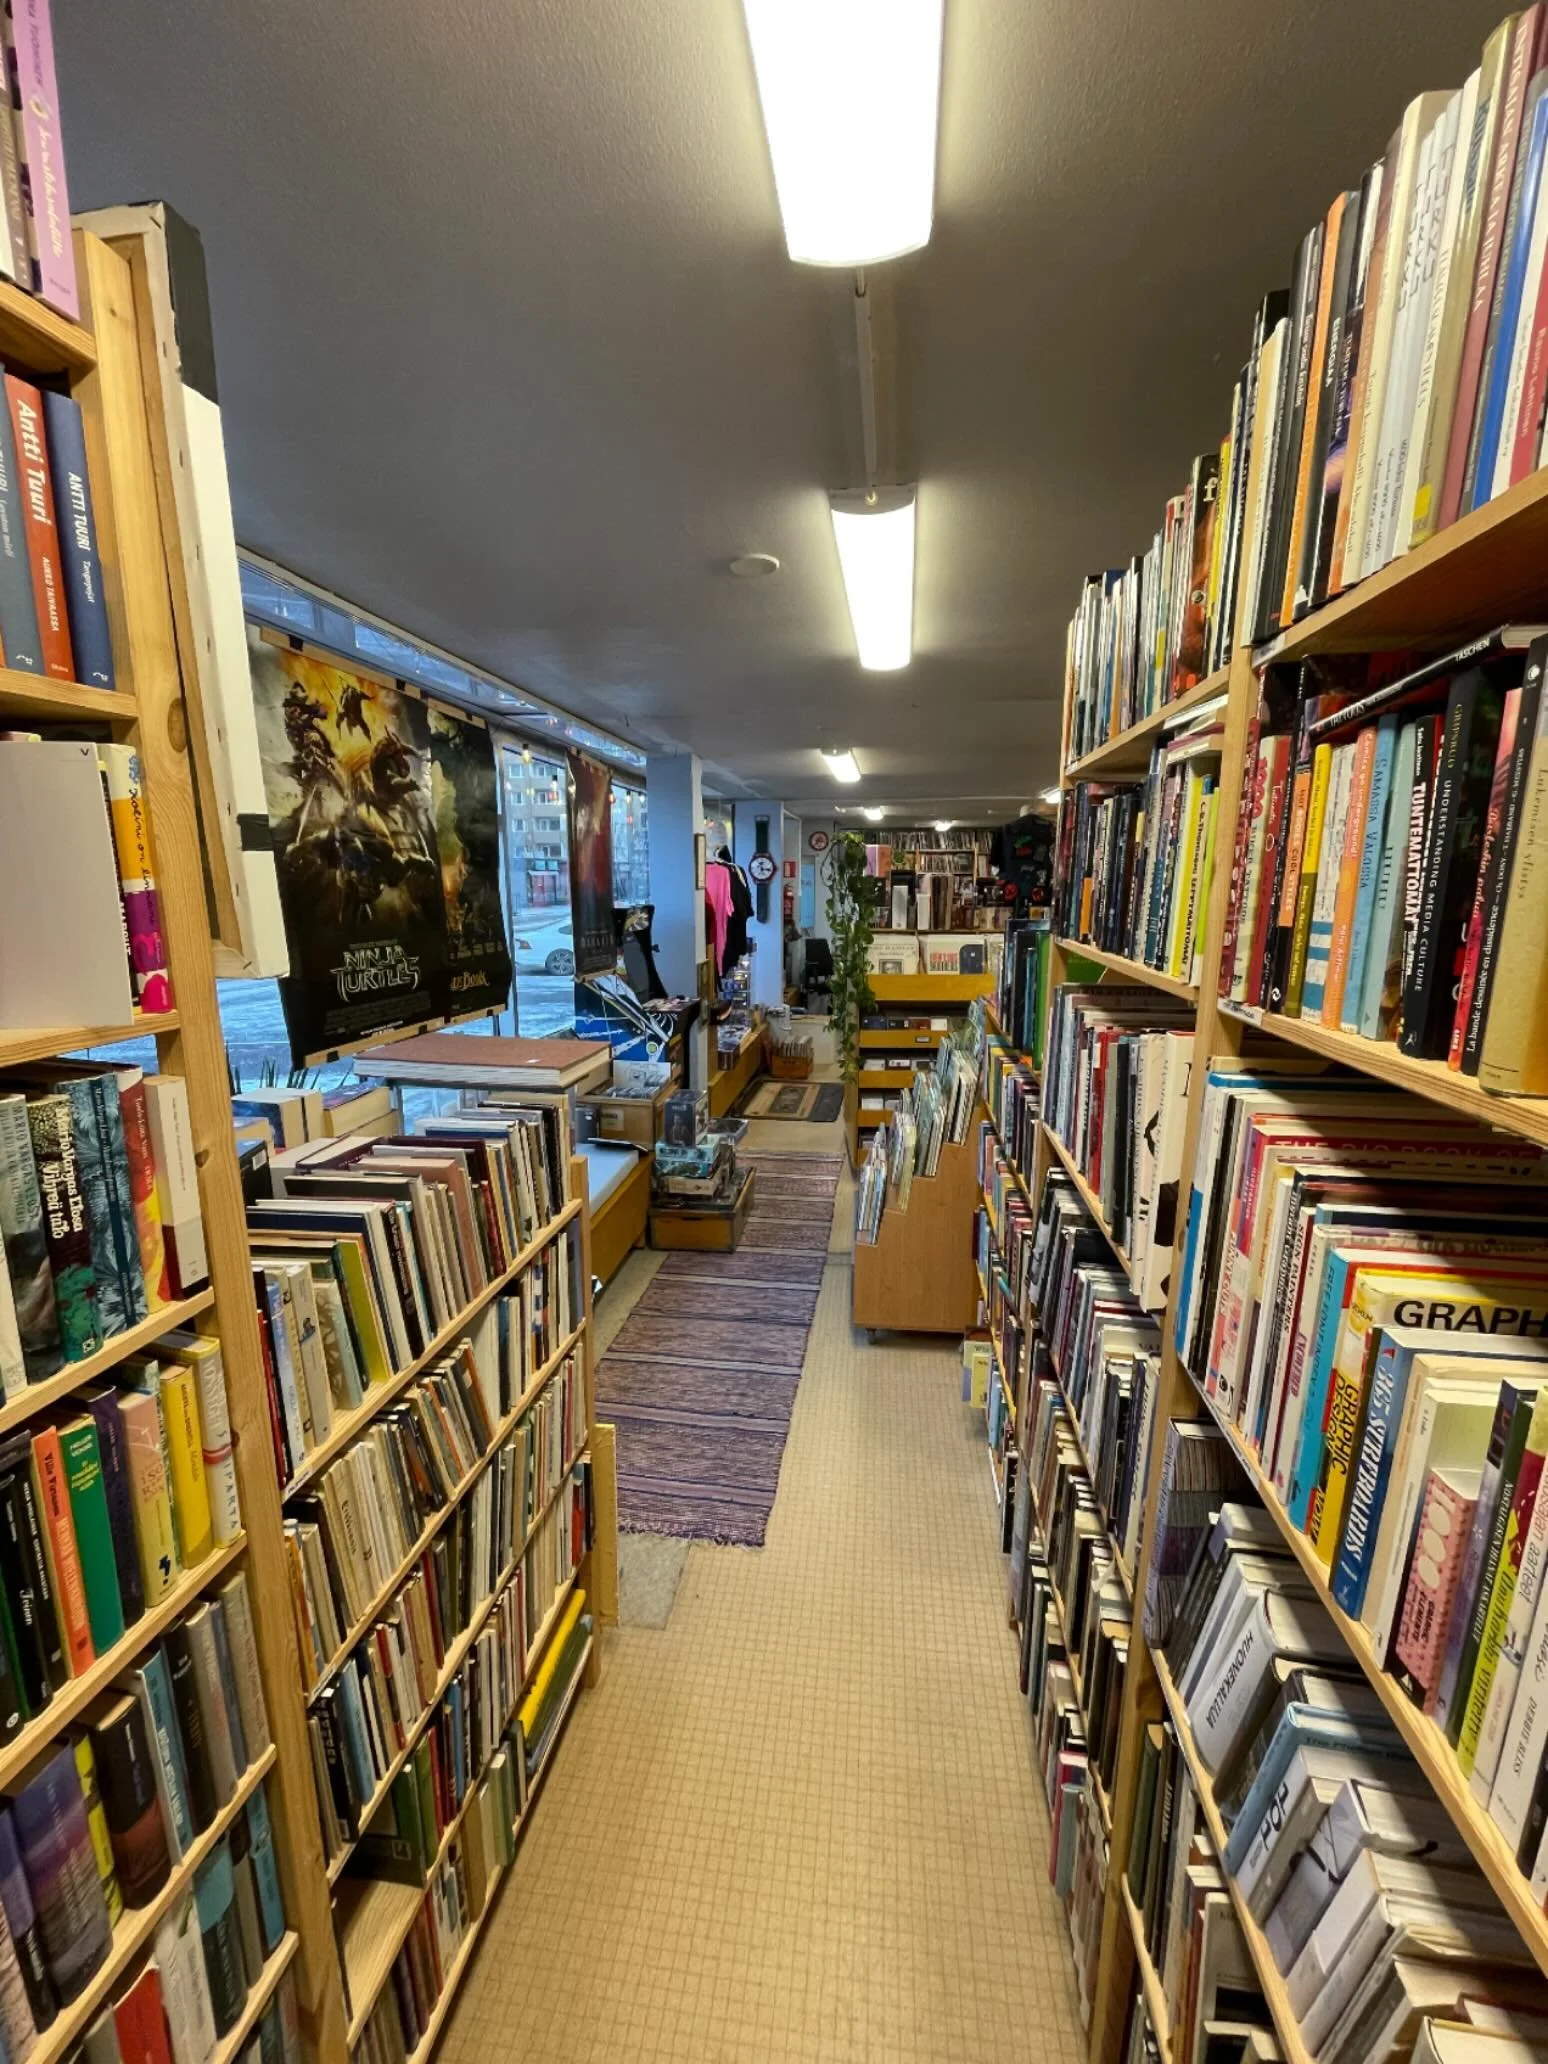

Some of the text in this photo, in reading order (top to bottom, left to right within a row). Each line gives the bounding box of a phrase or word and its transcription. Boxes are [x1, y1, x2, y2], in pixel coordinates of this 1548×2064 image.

[1491, 142, 1509, 209] ARKEA
[1475, 234, 1495, 313] JUHLAA
[1324, 317, 1341, 388] ENERGIAA
[1520, 326, 1547, 438] Rauno Lahtinen
[17, 399, 51, 524] Antti Tuuri
[68, 472, 87, 511] ANTTI
[74, 513, 91, 551] TUURI
[1454, 637, 1491, 663] TASCHEN
[1253, 756, 1268, 820] 1000
[1349, 733, 1375, 857] Comics go underground!
[1360, 758, 1385, 890] SAMASSA VALOSSA
[1429, 780, 1450, 889] UNDERSTANDING
[1517, 767, 1548, 901] Lukemisen ylistys
[1284, 875, 1297, 912] STYLES
[1422, 893, 1435, 934] MEDIA
[343, 945, 406, 971] NINJA
[1481, 904, 1500, 954] dissidence
[330, 956, 421, 1003] TURTLES
[1413, 938, 1429, 993] CULTURE
[1473, 969, 1488, 1010] dessinée
[1482, 955, 1490, 968] en
[1466, 1039, 1477, 1052] La
[1469, 1012, 1482, 1038] bande
[12, 1106, 26, 1141] MARIO
[15, 1143, 32, 1184] VARGAS
[56, 1107, 83, 1232] Mario Vargas Llosa
[43, 1163, 66, 1239] Vihreä talo
[1224, 1232, 1239, 1274] FUNNY
[1275, 1189, 1300, 1304] Instant Graphics
[1283, 1223, 1305, 1333] SIGN PAINTERS
[1323, 1265, 1337, 1300] FREE
[1315, 1302, 1331, 1337] FONT
[1394, 1300, 1548, 1337] GRAPH
[1325, 1376, 1347, 1449] DESIGN
[1331, 1384, 1359, 1476] GRAPHIC
[1343, 1366, 1394, 1561] 365 SURFBOARDS
[1494, 1480, 1513, 1546] NOSTALGISEN
[1517, 1541, 1547, 1605] aarteet
[1206, 1630, 1255, 1729] HUONEKALUJA
[1521, 1696, 1538, 1743] DEBBIE
[1514, 1743, 1530, 1778] BLISS
[1260, 1781, 1290, 1851] POP
